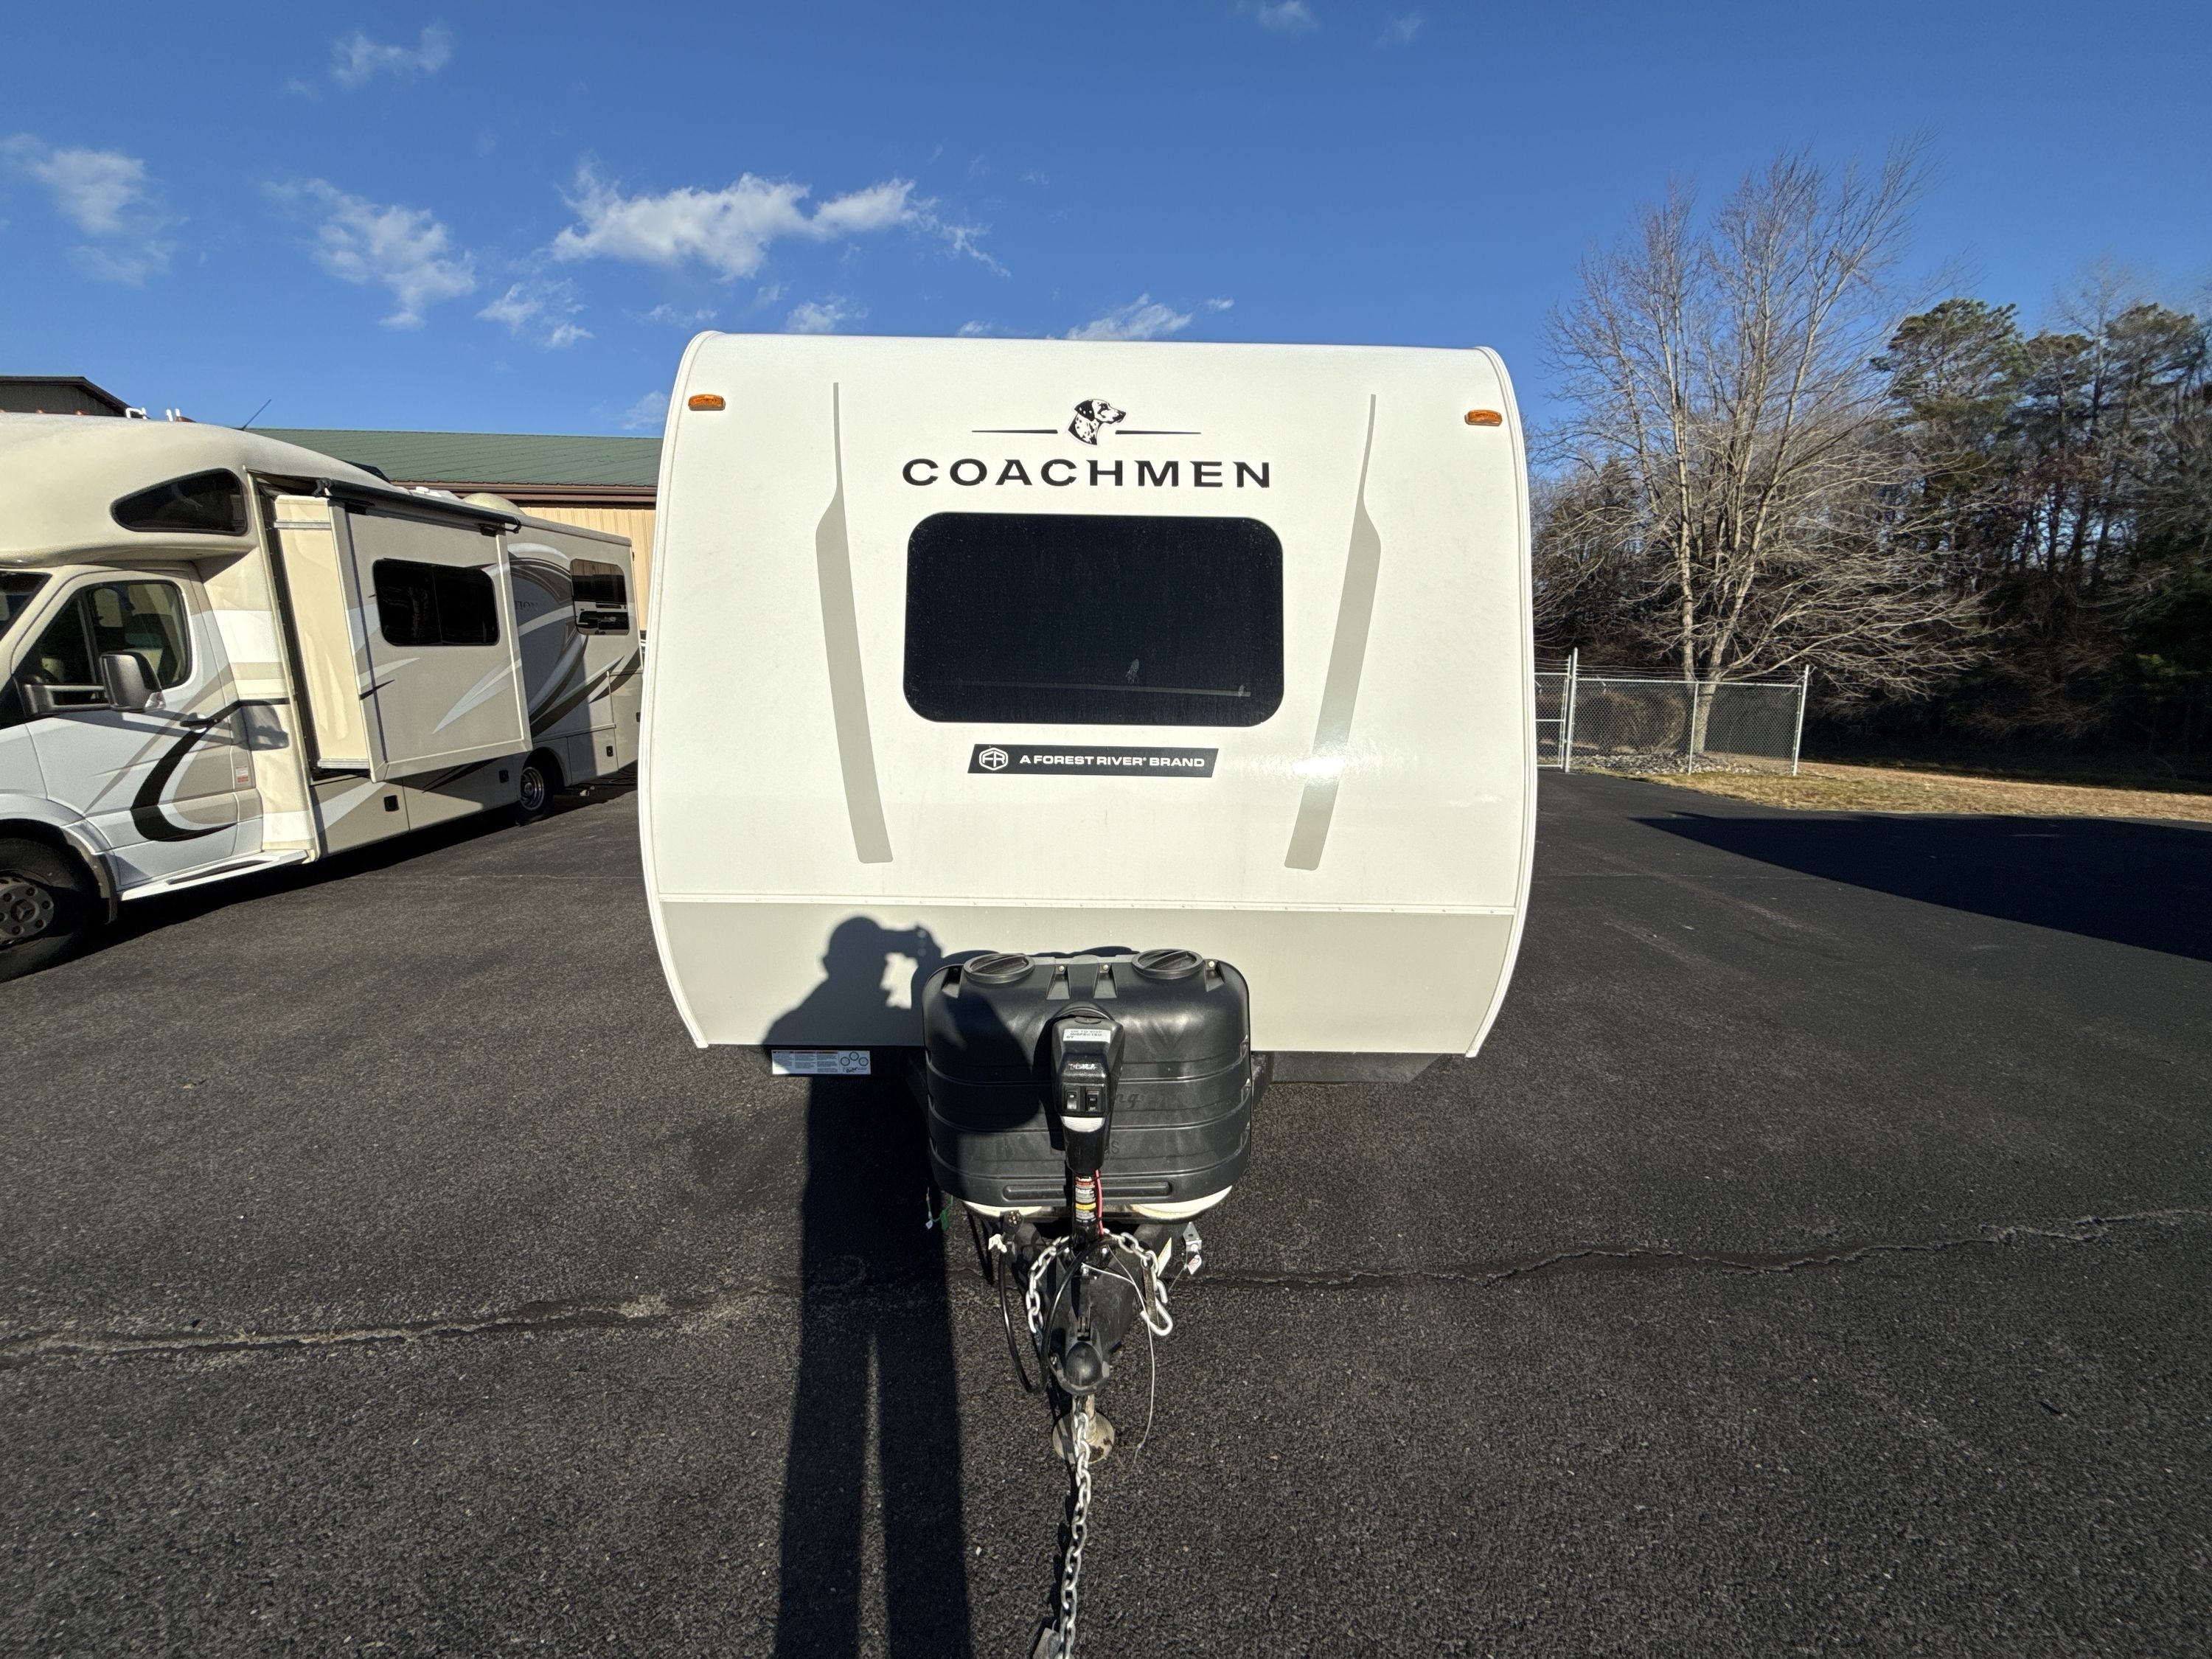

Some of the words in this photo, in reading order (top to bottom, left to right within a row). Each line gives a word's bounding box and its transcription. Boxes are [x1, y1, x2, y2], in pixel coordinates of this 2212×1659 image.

[902, 458, 1270, 487] COACHMEN
[1019, 755, 1032, 764] A
[1034, 755, 1094, 765] FOREST
[1149, 757, 1206, 767] BRAND
